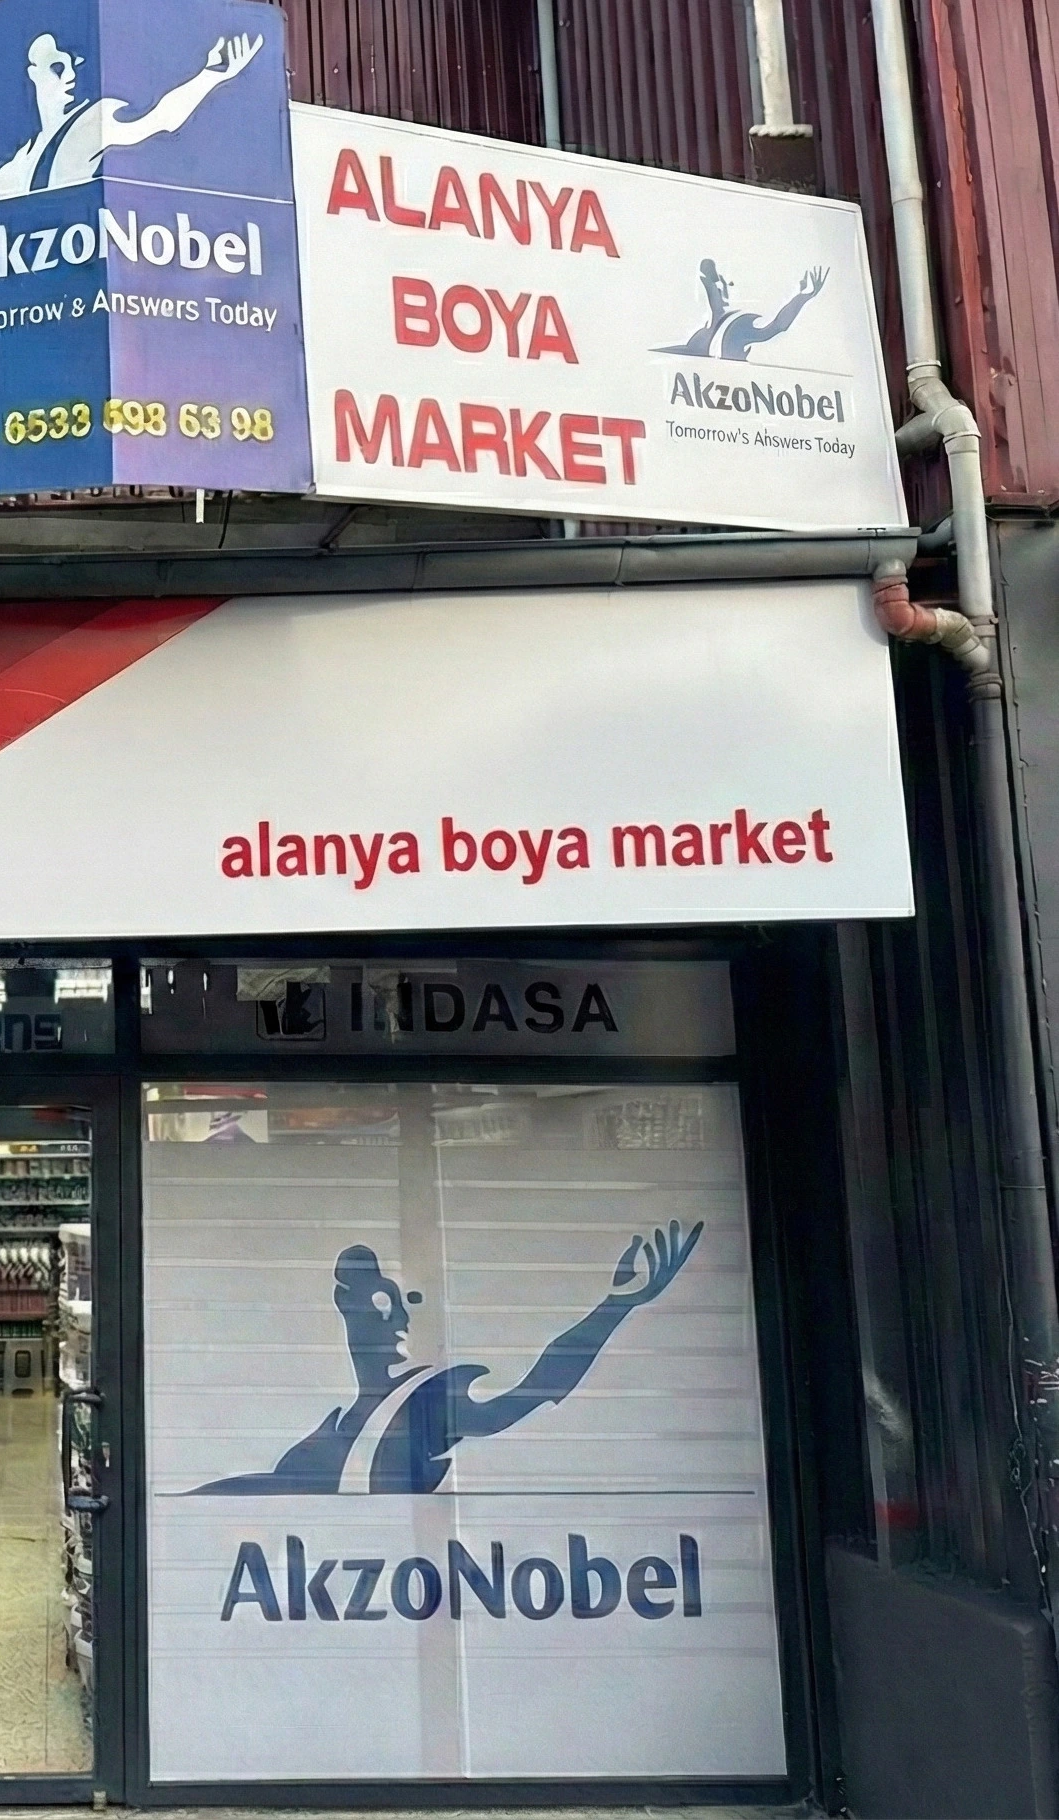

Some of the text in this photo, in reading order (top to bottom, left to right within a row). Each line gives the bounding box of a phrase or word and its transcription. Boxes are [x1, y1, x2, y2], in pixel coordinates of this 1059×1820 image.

[326, 148, 621, 259] ALANYA
[91, 289, 201, 321] Answers
[205, 297, 278, 333] Today
[392, 276, 580, 365] BOYA
[334, 388, 647, 486] MARKET
[670, 372, 845, 423] AkzoNobel
[665, 420, 856, 459] Tomorrow's Answers Today
[220, 808, 834, 890] alanya boya market
[351, 981, 619, 1033] INDASA
[220, 1534, 703, 1622] AkzoNobel
